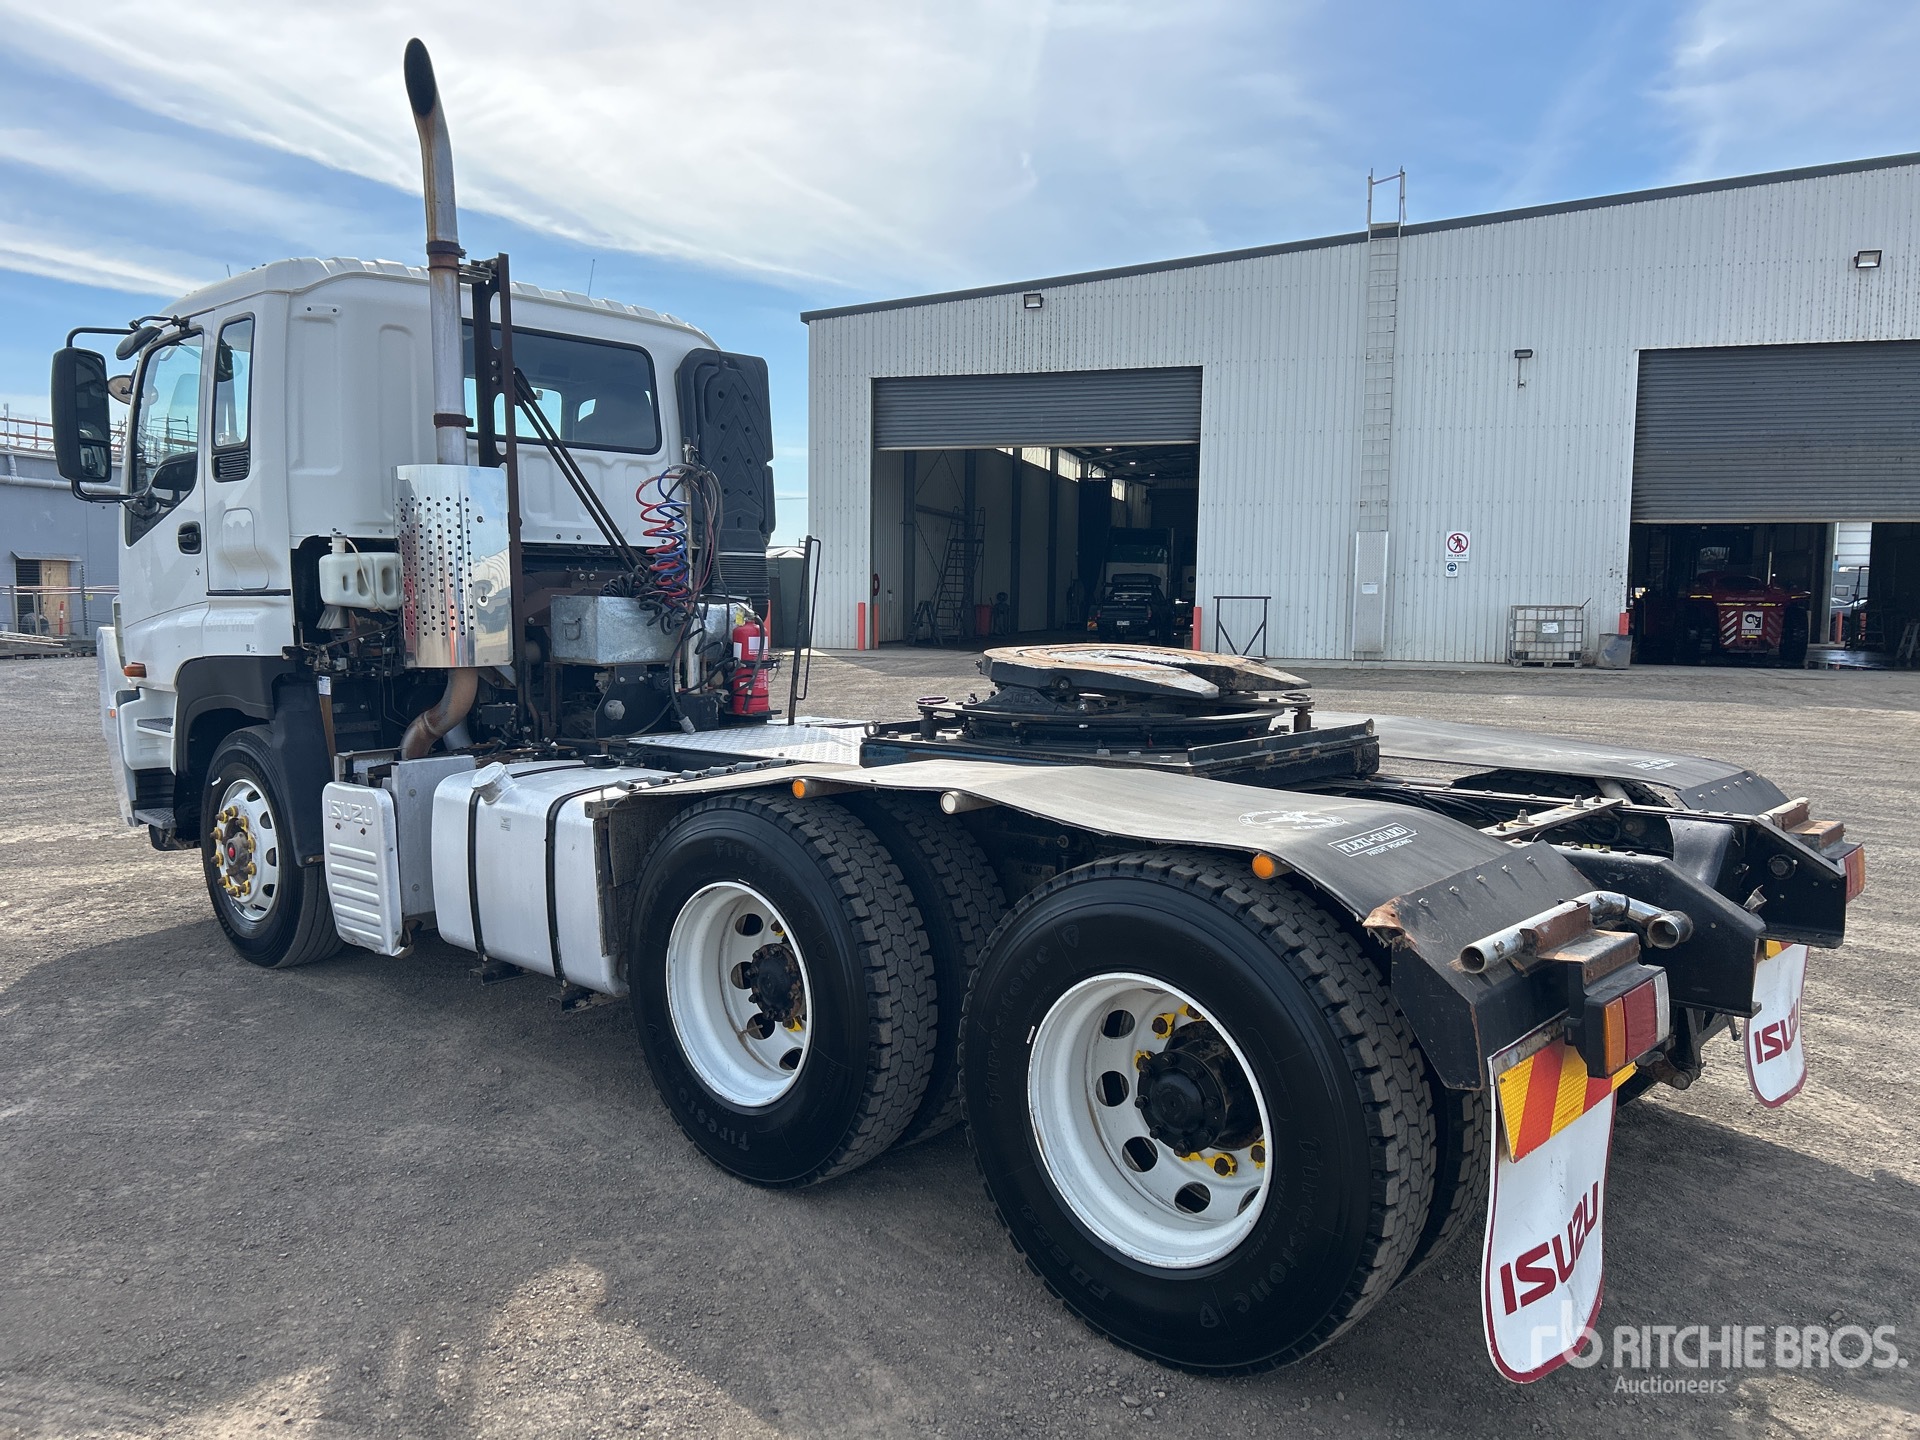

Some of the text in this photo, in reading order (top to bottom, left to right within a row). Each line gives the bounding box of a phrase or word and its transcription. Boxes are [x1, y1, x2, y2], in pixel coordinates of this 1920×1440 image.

[327, 799, 373, 825] ISUZU
[1337, 827, 1408, 853] FLEXI-GUARD
[1500, 1181, 1599, 1315] ISUZU
